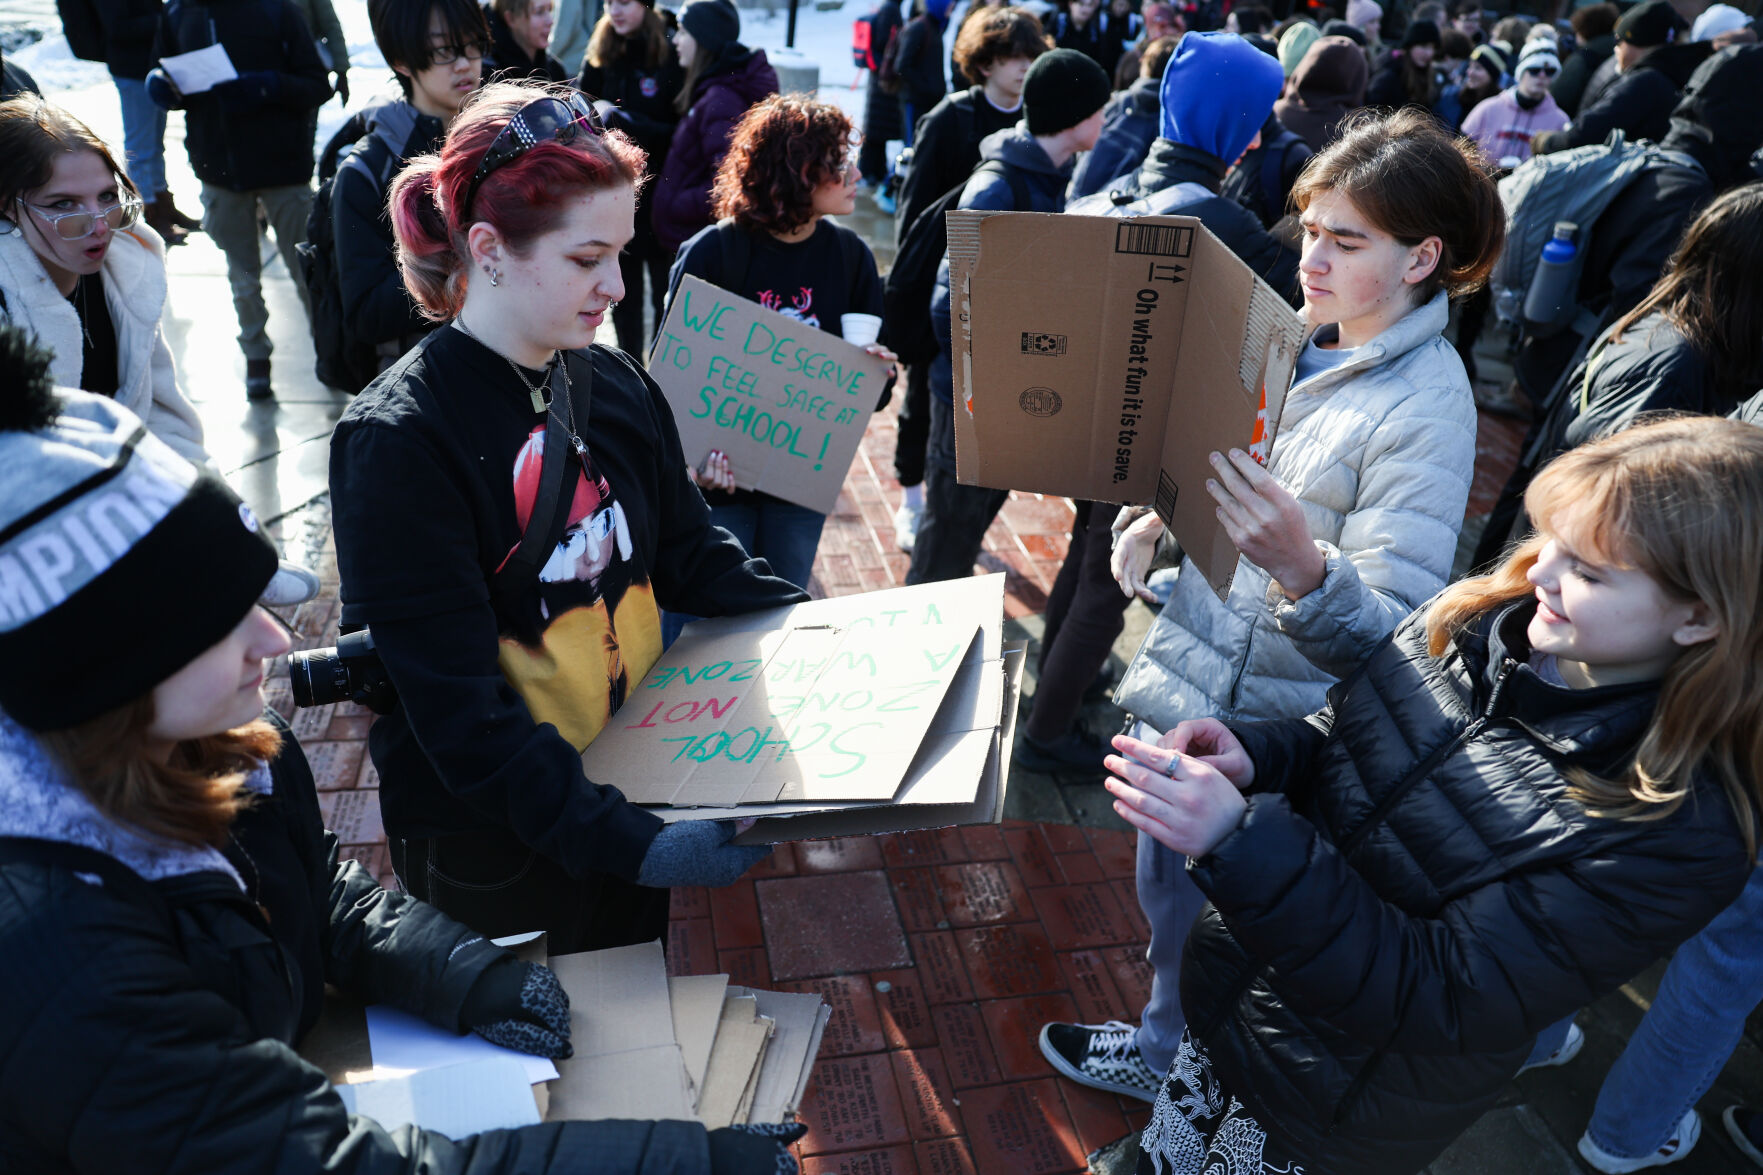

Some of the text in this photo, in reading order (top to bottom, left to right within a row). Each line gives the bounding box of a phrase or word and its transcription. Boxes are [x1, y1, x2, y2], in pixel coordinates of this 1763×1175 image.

[661, 331, 860, 425] TO FEEL SAFE AT
[683, 291, 865, 395] WE DESERVE
[1113, 289, 1159, 484] Oh what fun it is to save.
[923, 643, 961, 672] A
[625, 696, 738, 729] NOT
[660, 722, 884, 778] SCHOOL
